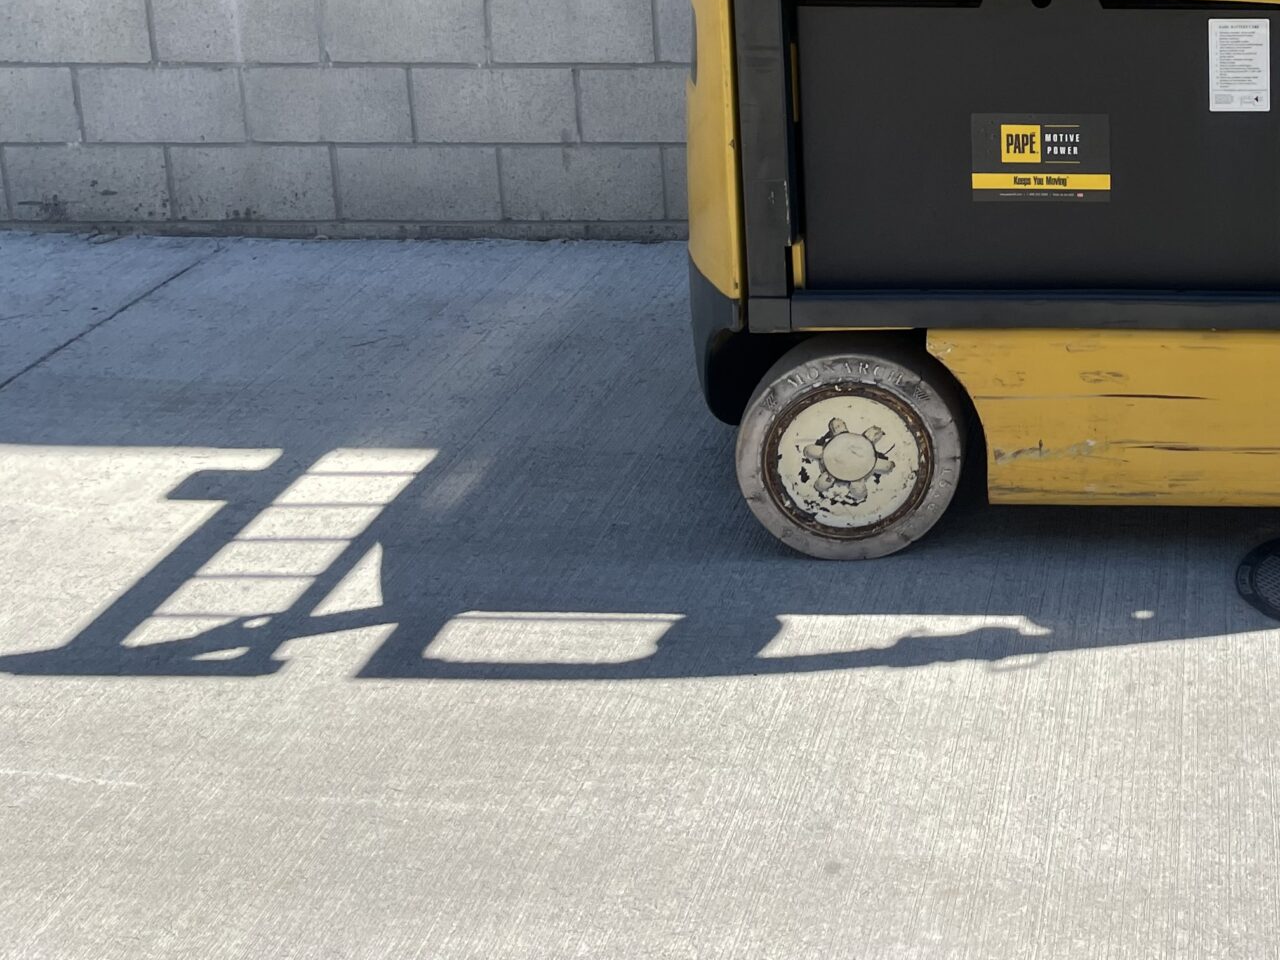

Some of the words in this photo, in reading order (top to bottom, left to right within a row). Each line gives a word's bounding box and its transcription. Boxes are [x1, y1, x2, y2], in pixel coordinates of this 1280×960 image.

[1044, 133, 1080, 143] MOTIVE
[1047, 146, 1079, 155] POWER
[1013, 176, 1031, 186] Keeps
[1033, 176, 1044, 186] You
[1045, 176, 1067, 187] Moving
